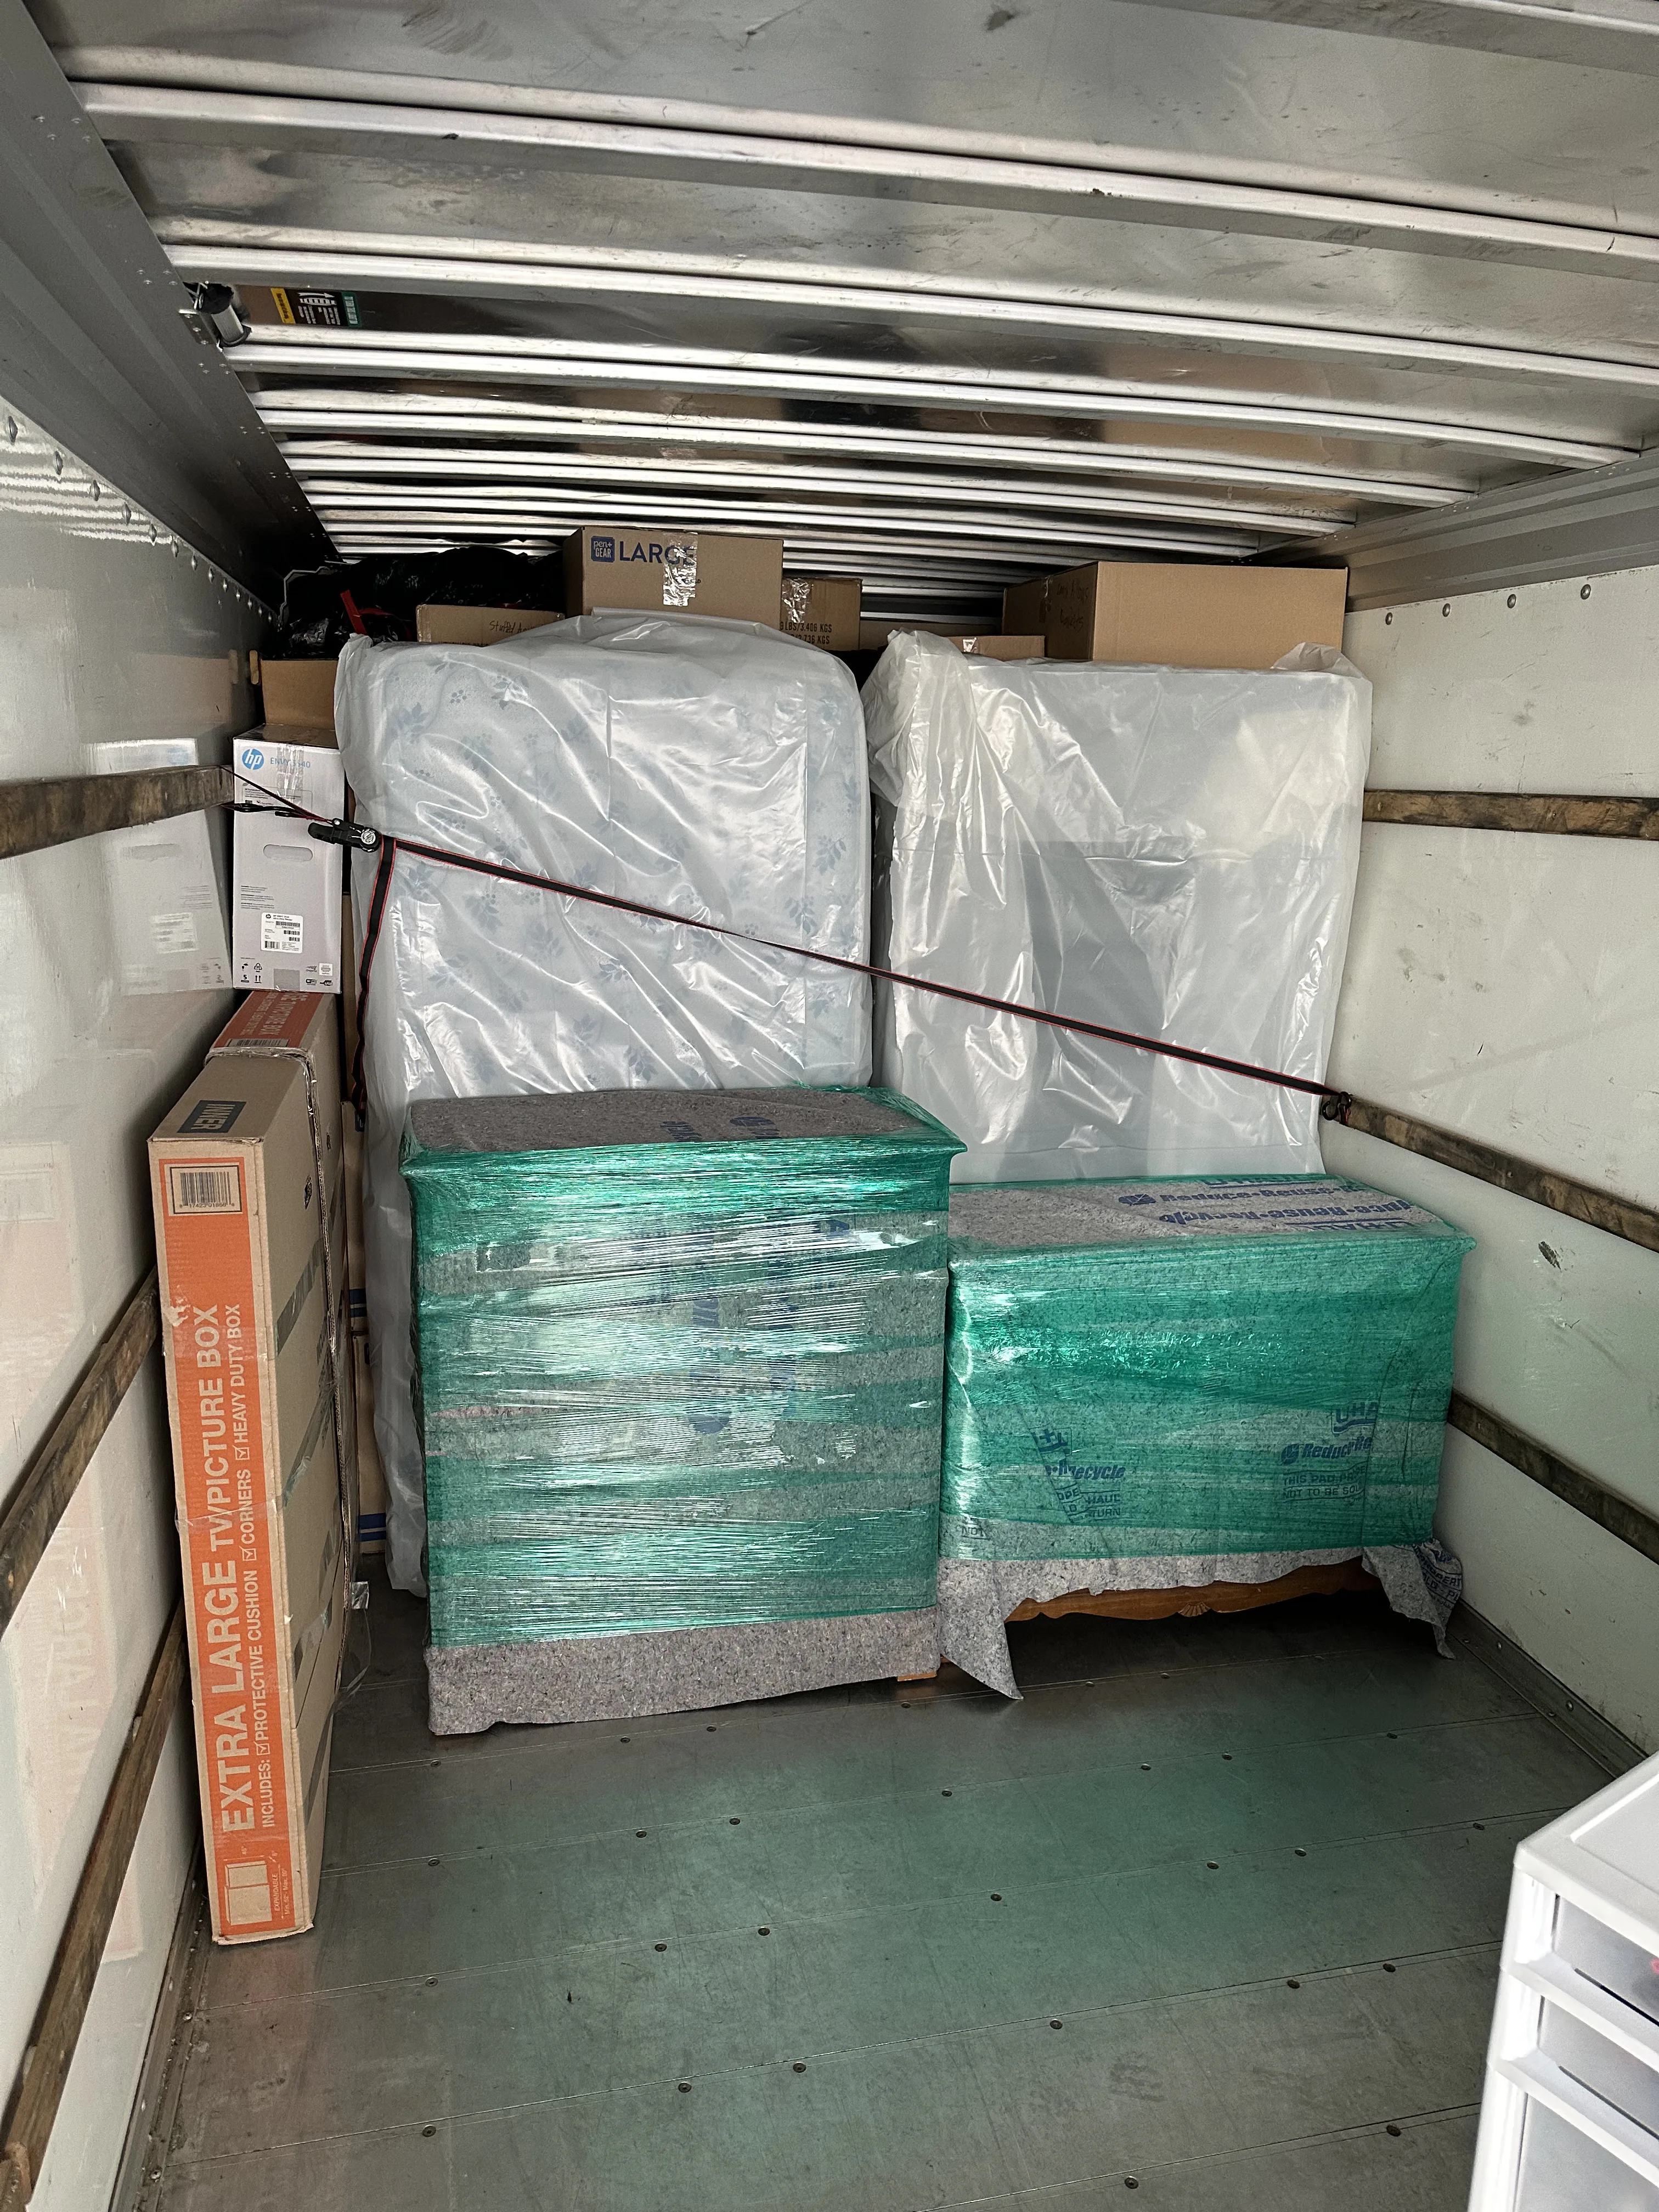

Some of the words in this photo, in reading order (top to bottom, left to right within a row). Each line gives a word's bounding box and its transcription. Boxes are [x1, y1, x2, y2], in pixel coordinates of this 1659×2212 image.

[595, 548, 612, 558] GEAR
[619, 541, 697, 567] LARGE
[817, 635, 830, 645] KGS
[820, 623, 832, 633] KGS
[243, 748, 263, 770] hp
[258, 1025, 283, 1036] BOX
[191, 1104, 235, 1130] INNER
[193, 1304, 222, 1368] BOX
[225, 1304, 242, 1339] BOX
[228, 1344, 245, 1387] DUTY
[230, 1392, 249, 1443] HEAVY
[236, 1469, 255, 1544] CORNERS
[1307, 1488, 1321, 1497] TO
[1324, 1488, 1339, 1496] BE
[243, 1570, 262, 1641] CUSHION
[202, 1560, 246, 1694] LARGE
[249, 1645, 269, 1741] PROTECTIVE
[213, 1703, 255, 1832] EXTRA
[258, 1759, 275, 1828] INCLUDES:
[272, 1873, 280, 1911] EXPANDABLE
